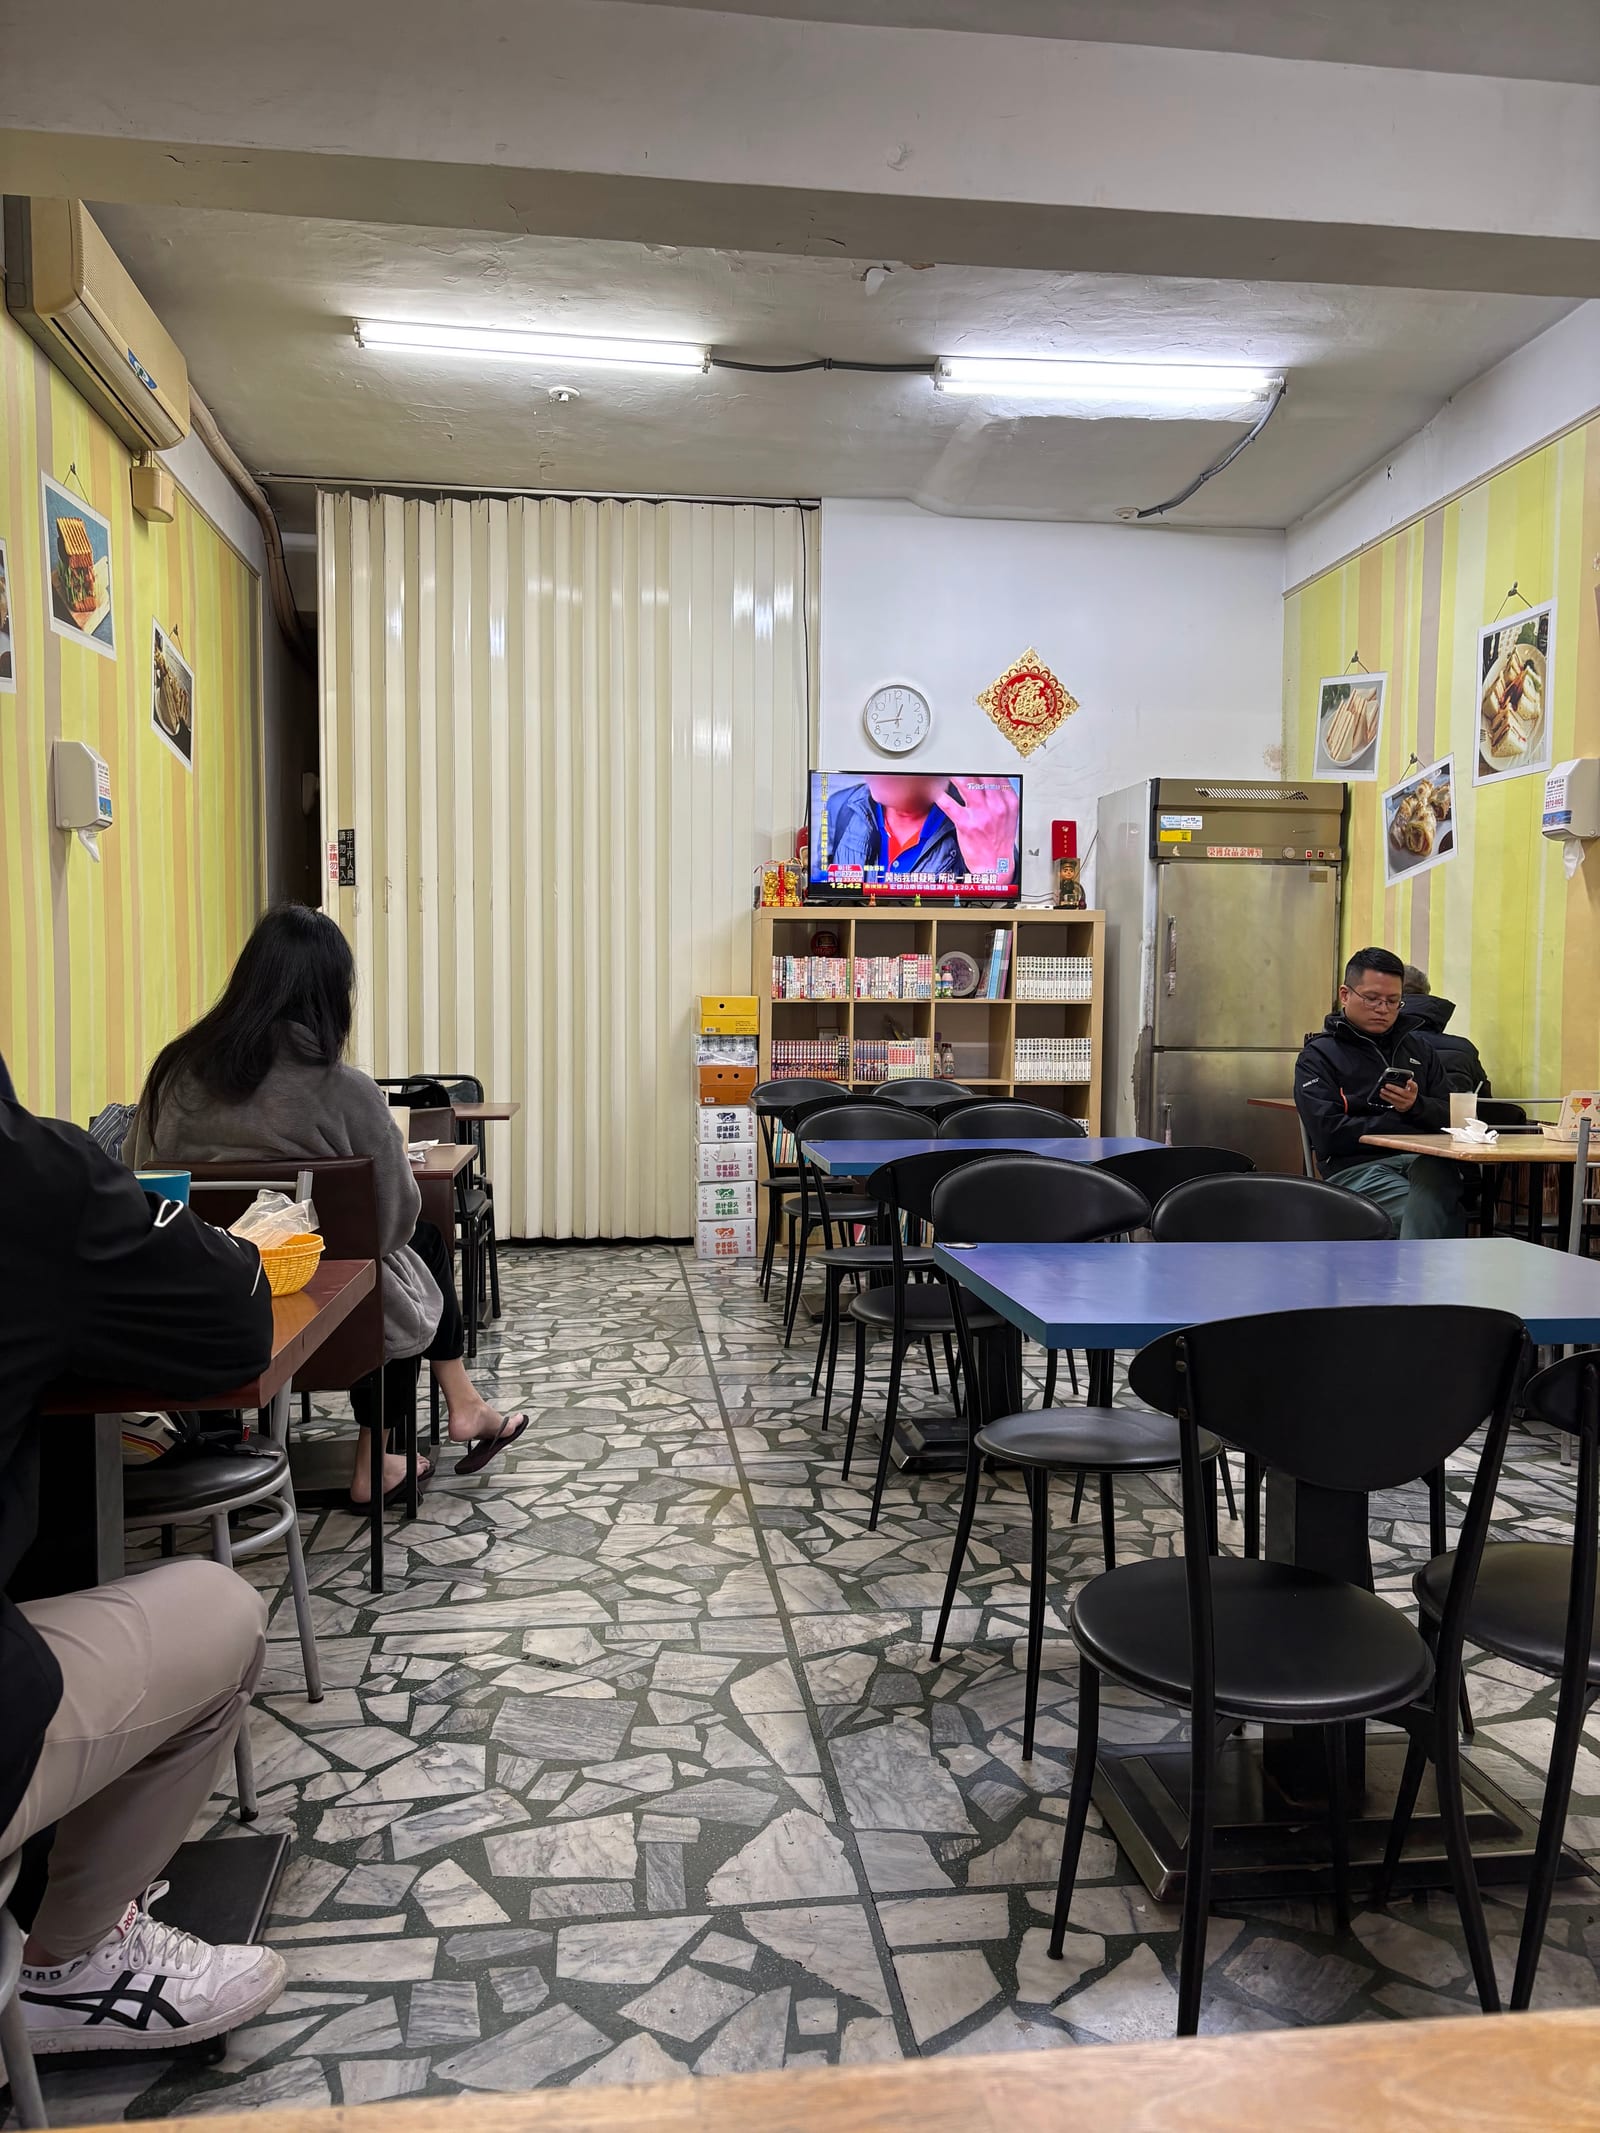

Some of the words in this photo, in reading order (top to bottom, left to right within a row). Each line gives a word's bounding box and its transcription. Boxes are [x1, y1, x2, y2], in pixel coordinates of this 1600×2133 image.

[914, 703, 921, 713] 2
[871, 712, 879, 722] 9
[917, 714, 924, 724] 3
[874, 724, 881, 735] 8
[914, 726, 920, 735] 4
[883, 734, 890, 745] 7
[894, 737, 901, 747] 6
[905, 735, 913, 744] 5
[339, 831, 347, 880] 請勿進入
[346, 831, 355, 880] 非工作人員
[329, 844, 338, 879] 非請勿進
